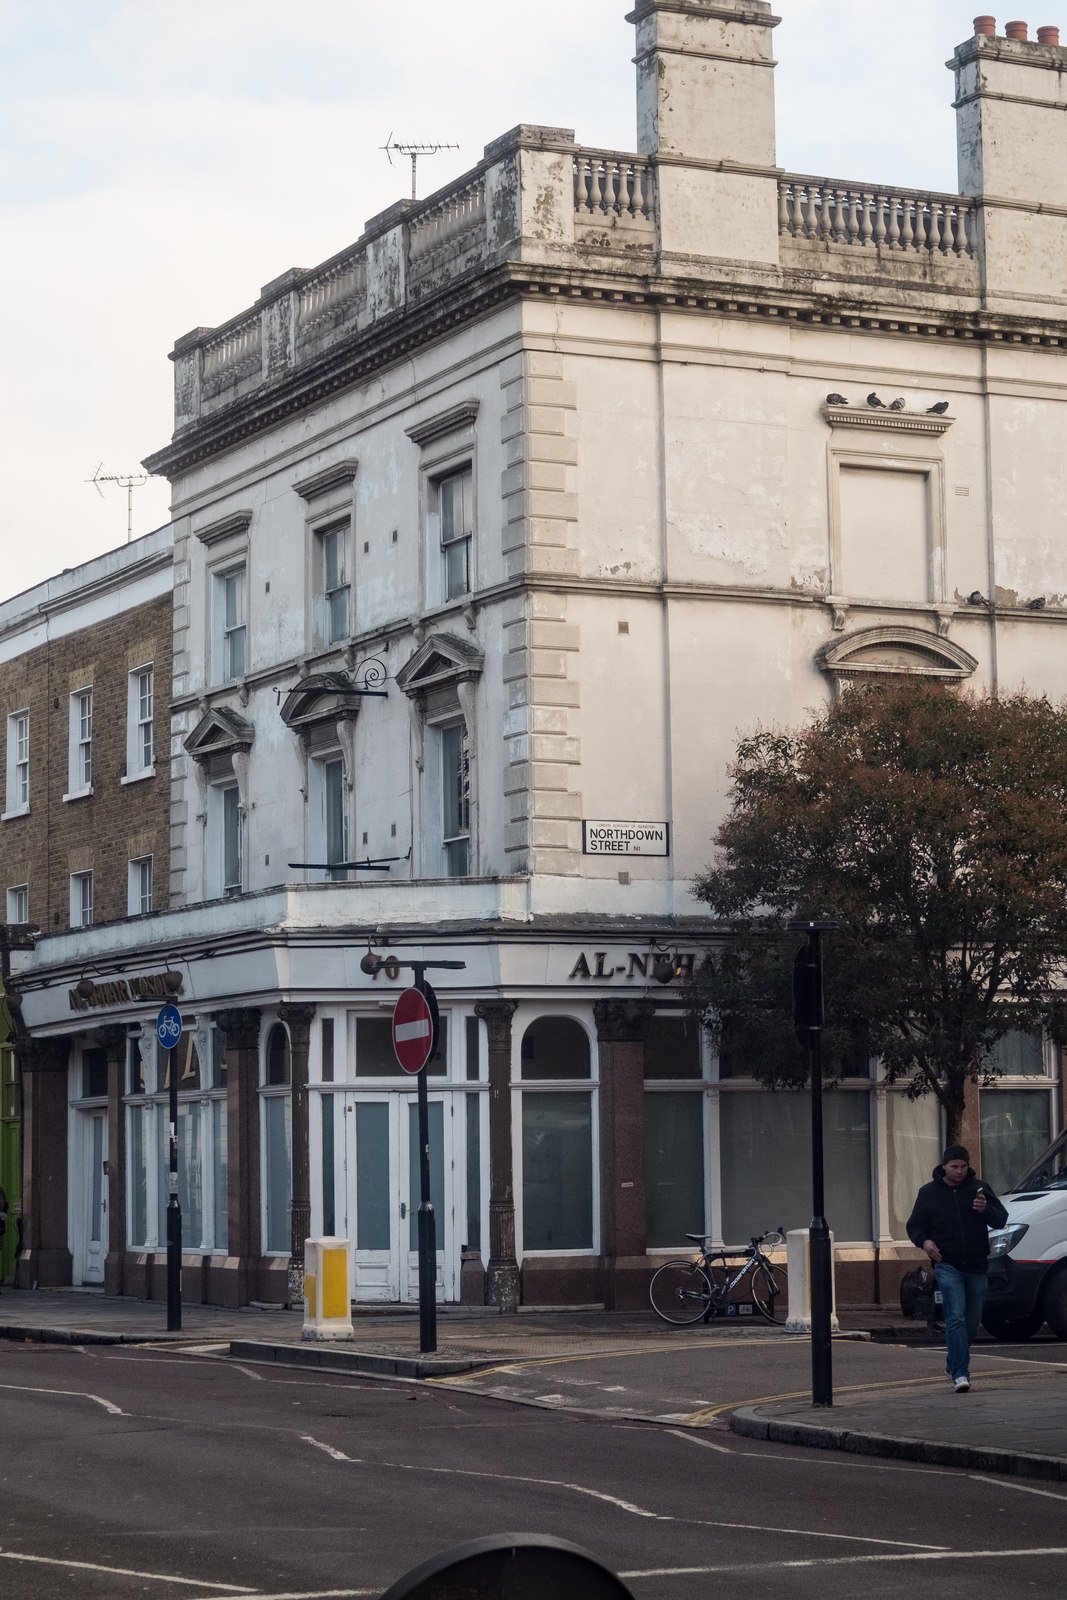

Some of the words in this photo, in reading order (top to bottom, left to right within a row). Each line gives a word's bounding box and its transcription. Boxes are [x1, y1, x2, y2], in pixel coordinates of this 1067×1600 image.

[590, 828, 663, 841] NORTHDOWN
[590, 840, 630, 851] STREET
[127, 973, 184, 997] MOSQ
